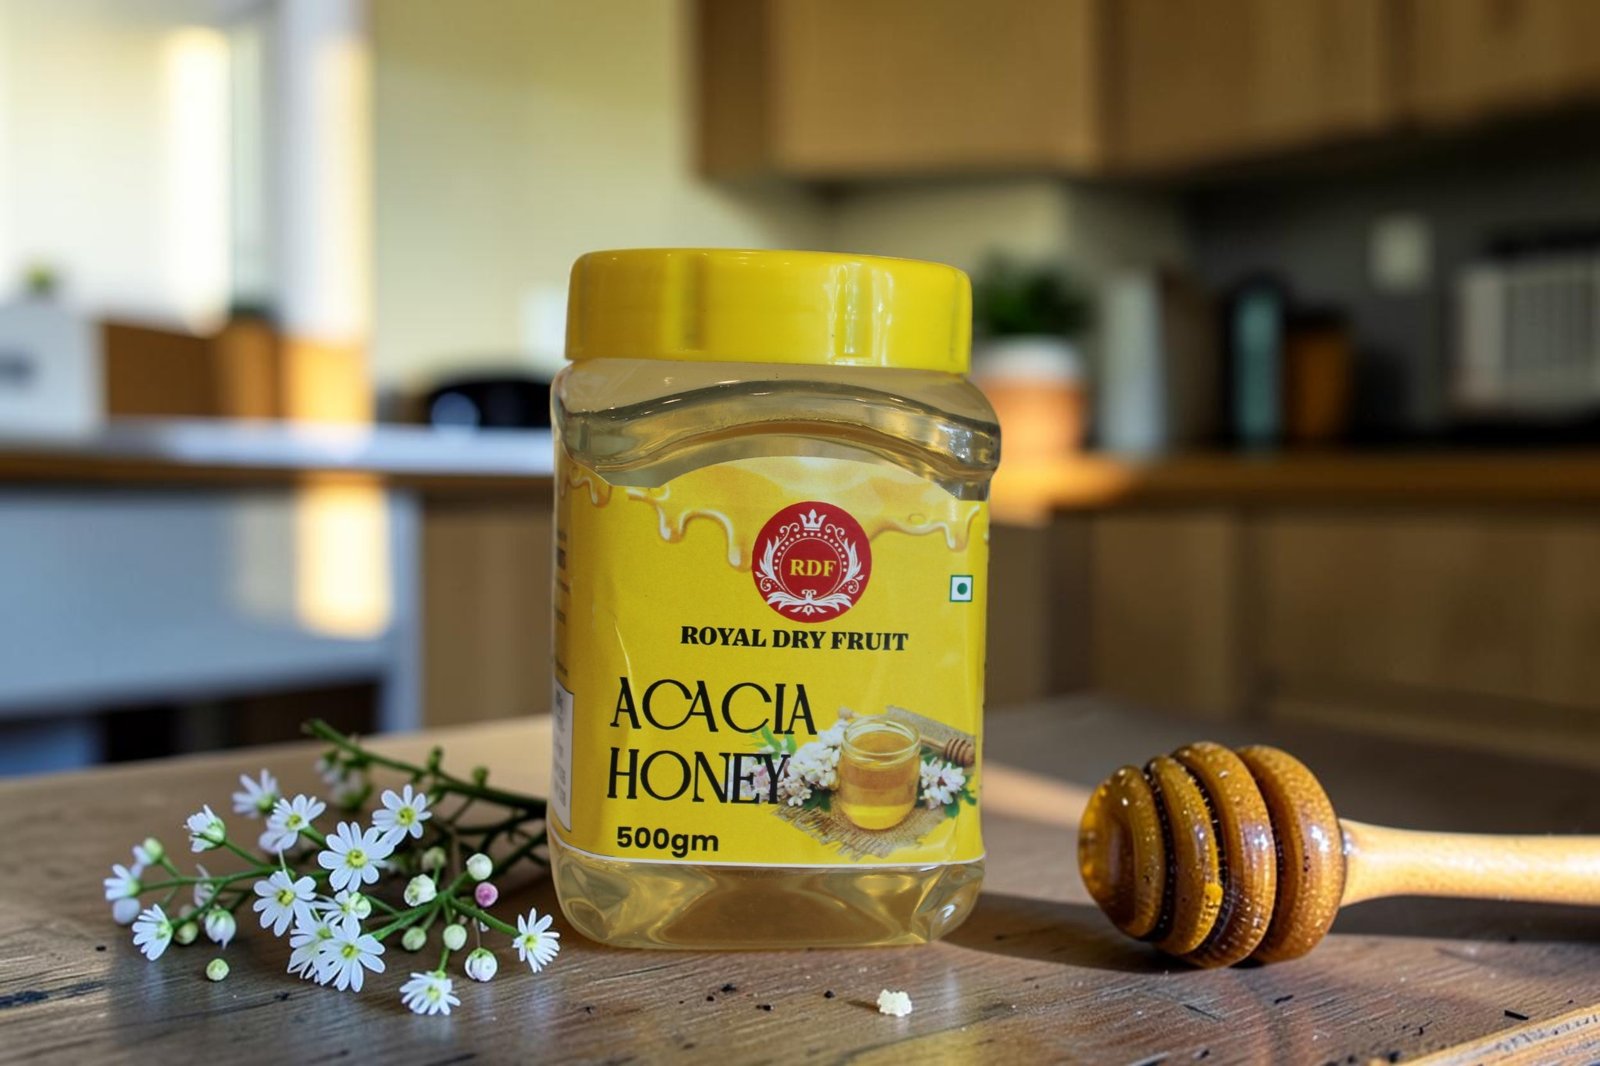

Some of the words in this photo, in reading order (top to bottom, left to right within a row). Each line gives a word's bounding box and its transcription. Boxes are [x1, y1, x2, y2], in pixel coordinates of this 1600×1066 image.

[789, 558, 837, 577] RDF
[680, 625, 767, 648] ROYAL
[772, 629, 826, 650] DRY
[830, 631, 909, 651] FRUIT
[610, 676, 817, 735] ACACIA
[607, 746, 791, 805] HONEY
[617, 826, 719, 858] 500gm
